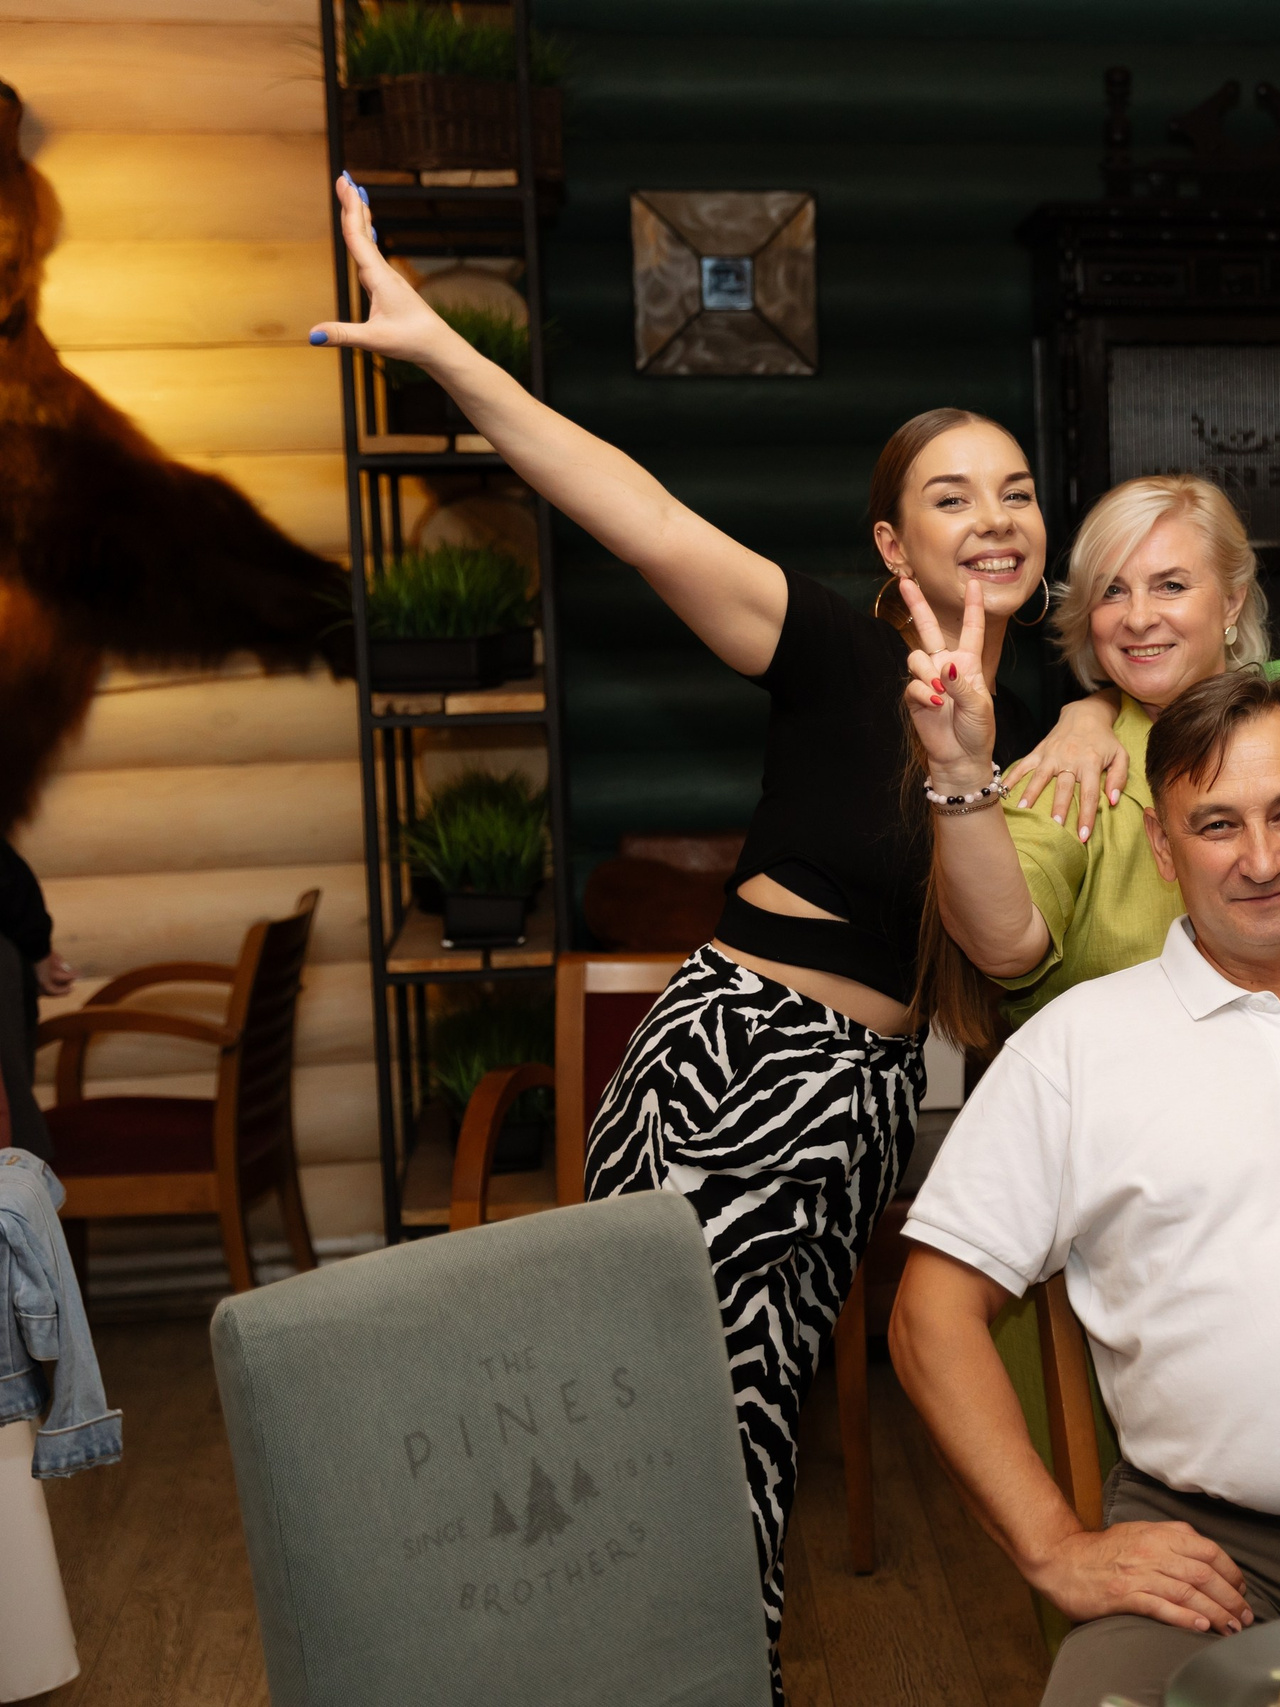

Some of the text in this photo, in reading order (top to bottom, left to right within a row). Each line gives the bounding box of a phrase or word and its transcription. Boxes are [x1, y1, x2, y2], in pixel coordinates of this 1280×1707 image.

[479, 1345, 536, 1382] THE
[404, 1366, 637, 1480] PINES
[402, 1515, 468, 1560] SINCE
[459, 1519, 647, 1617] BROTHERS
